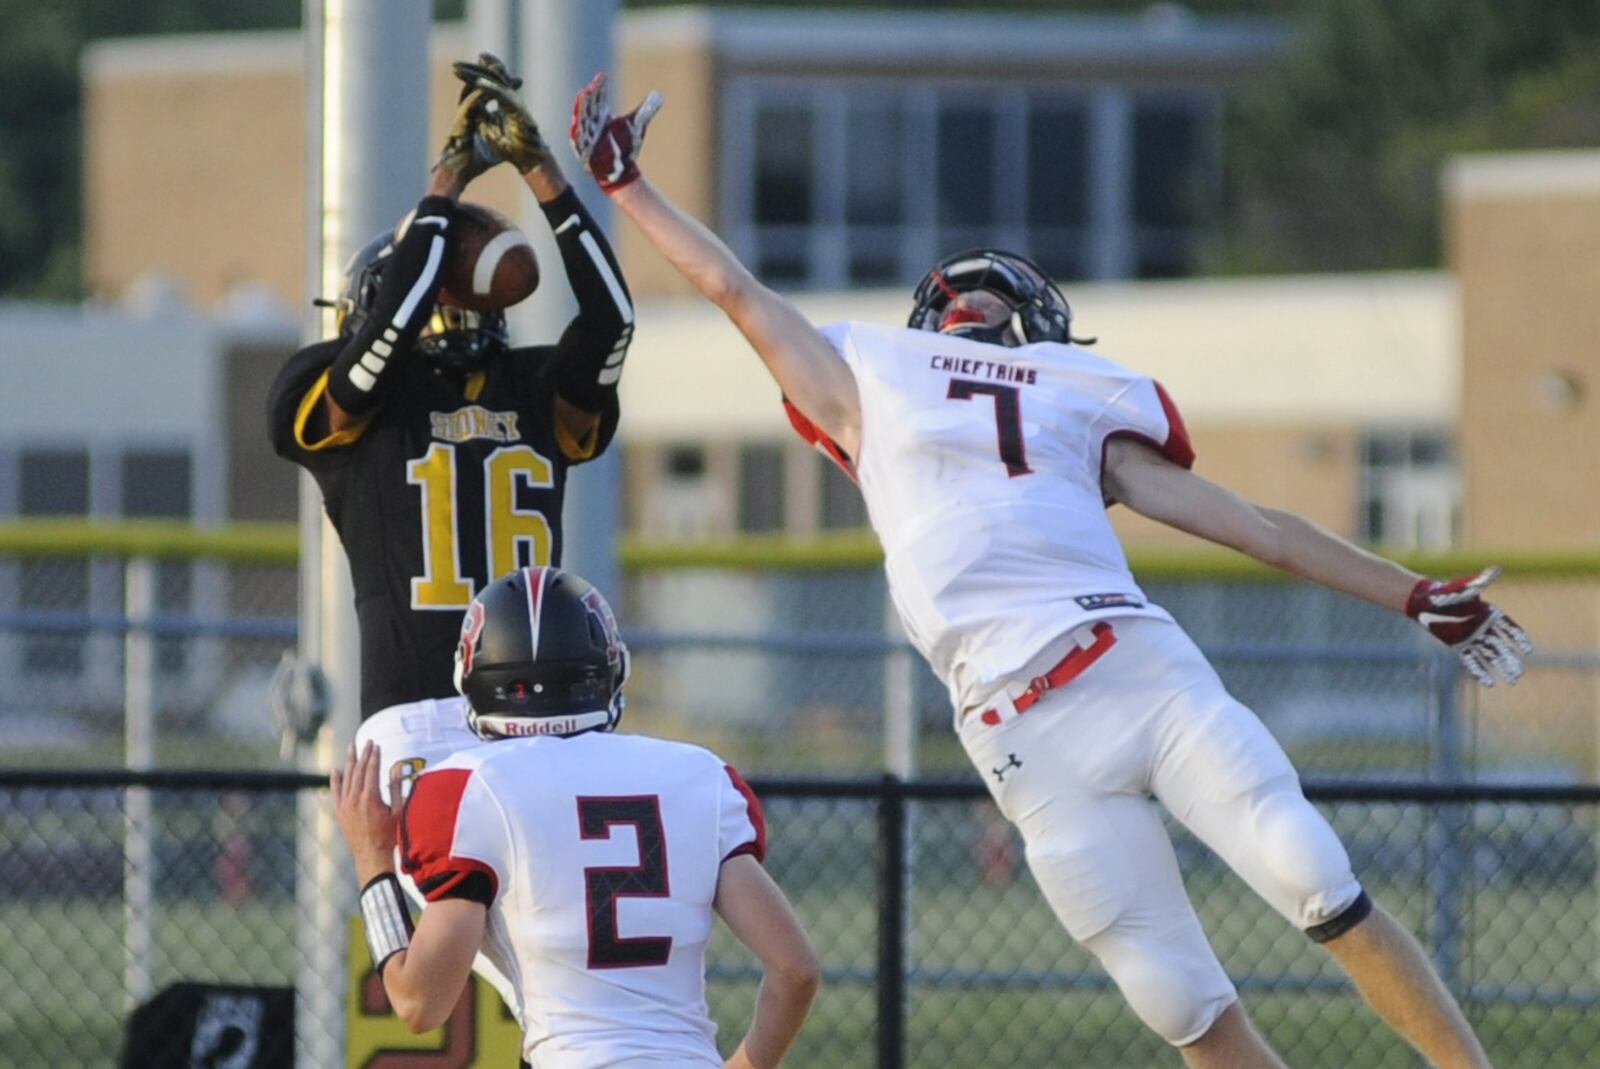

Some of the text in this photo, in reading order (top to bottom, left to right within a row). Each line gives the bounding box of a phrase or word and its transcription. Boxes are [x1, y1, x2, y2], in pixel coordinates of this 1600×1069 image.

[930, 355, 1037, 385] CHIEFTAINS
[946, 378, 1035, 477] 7
[406, 442, 554, 611] 16
[504, 719, 577, 736] Riddell
[576, 795, 673, 970] 2
